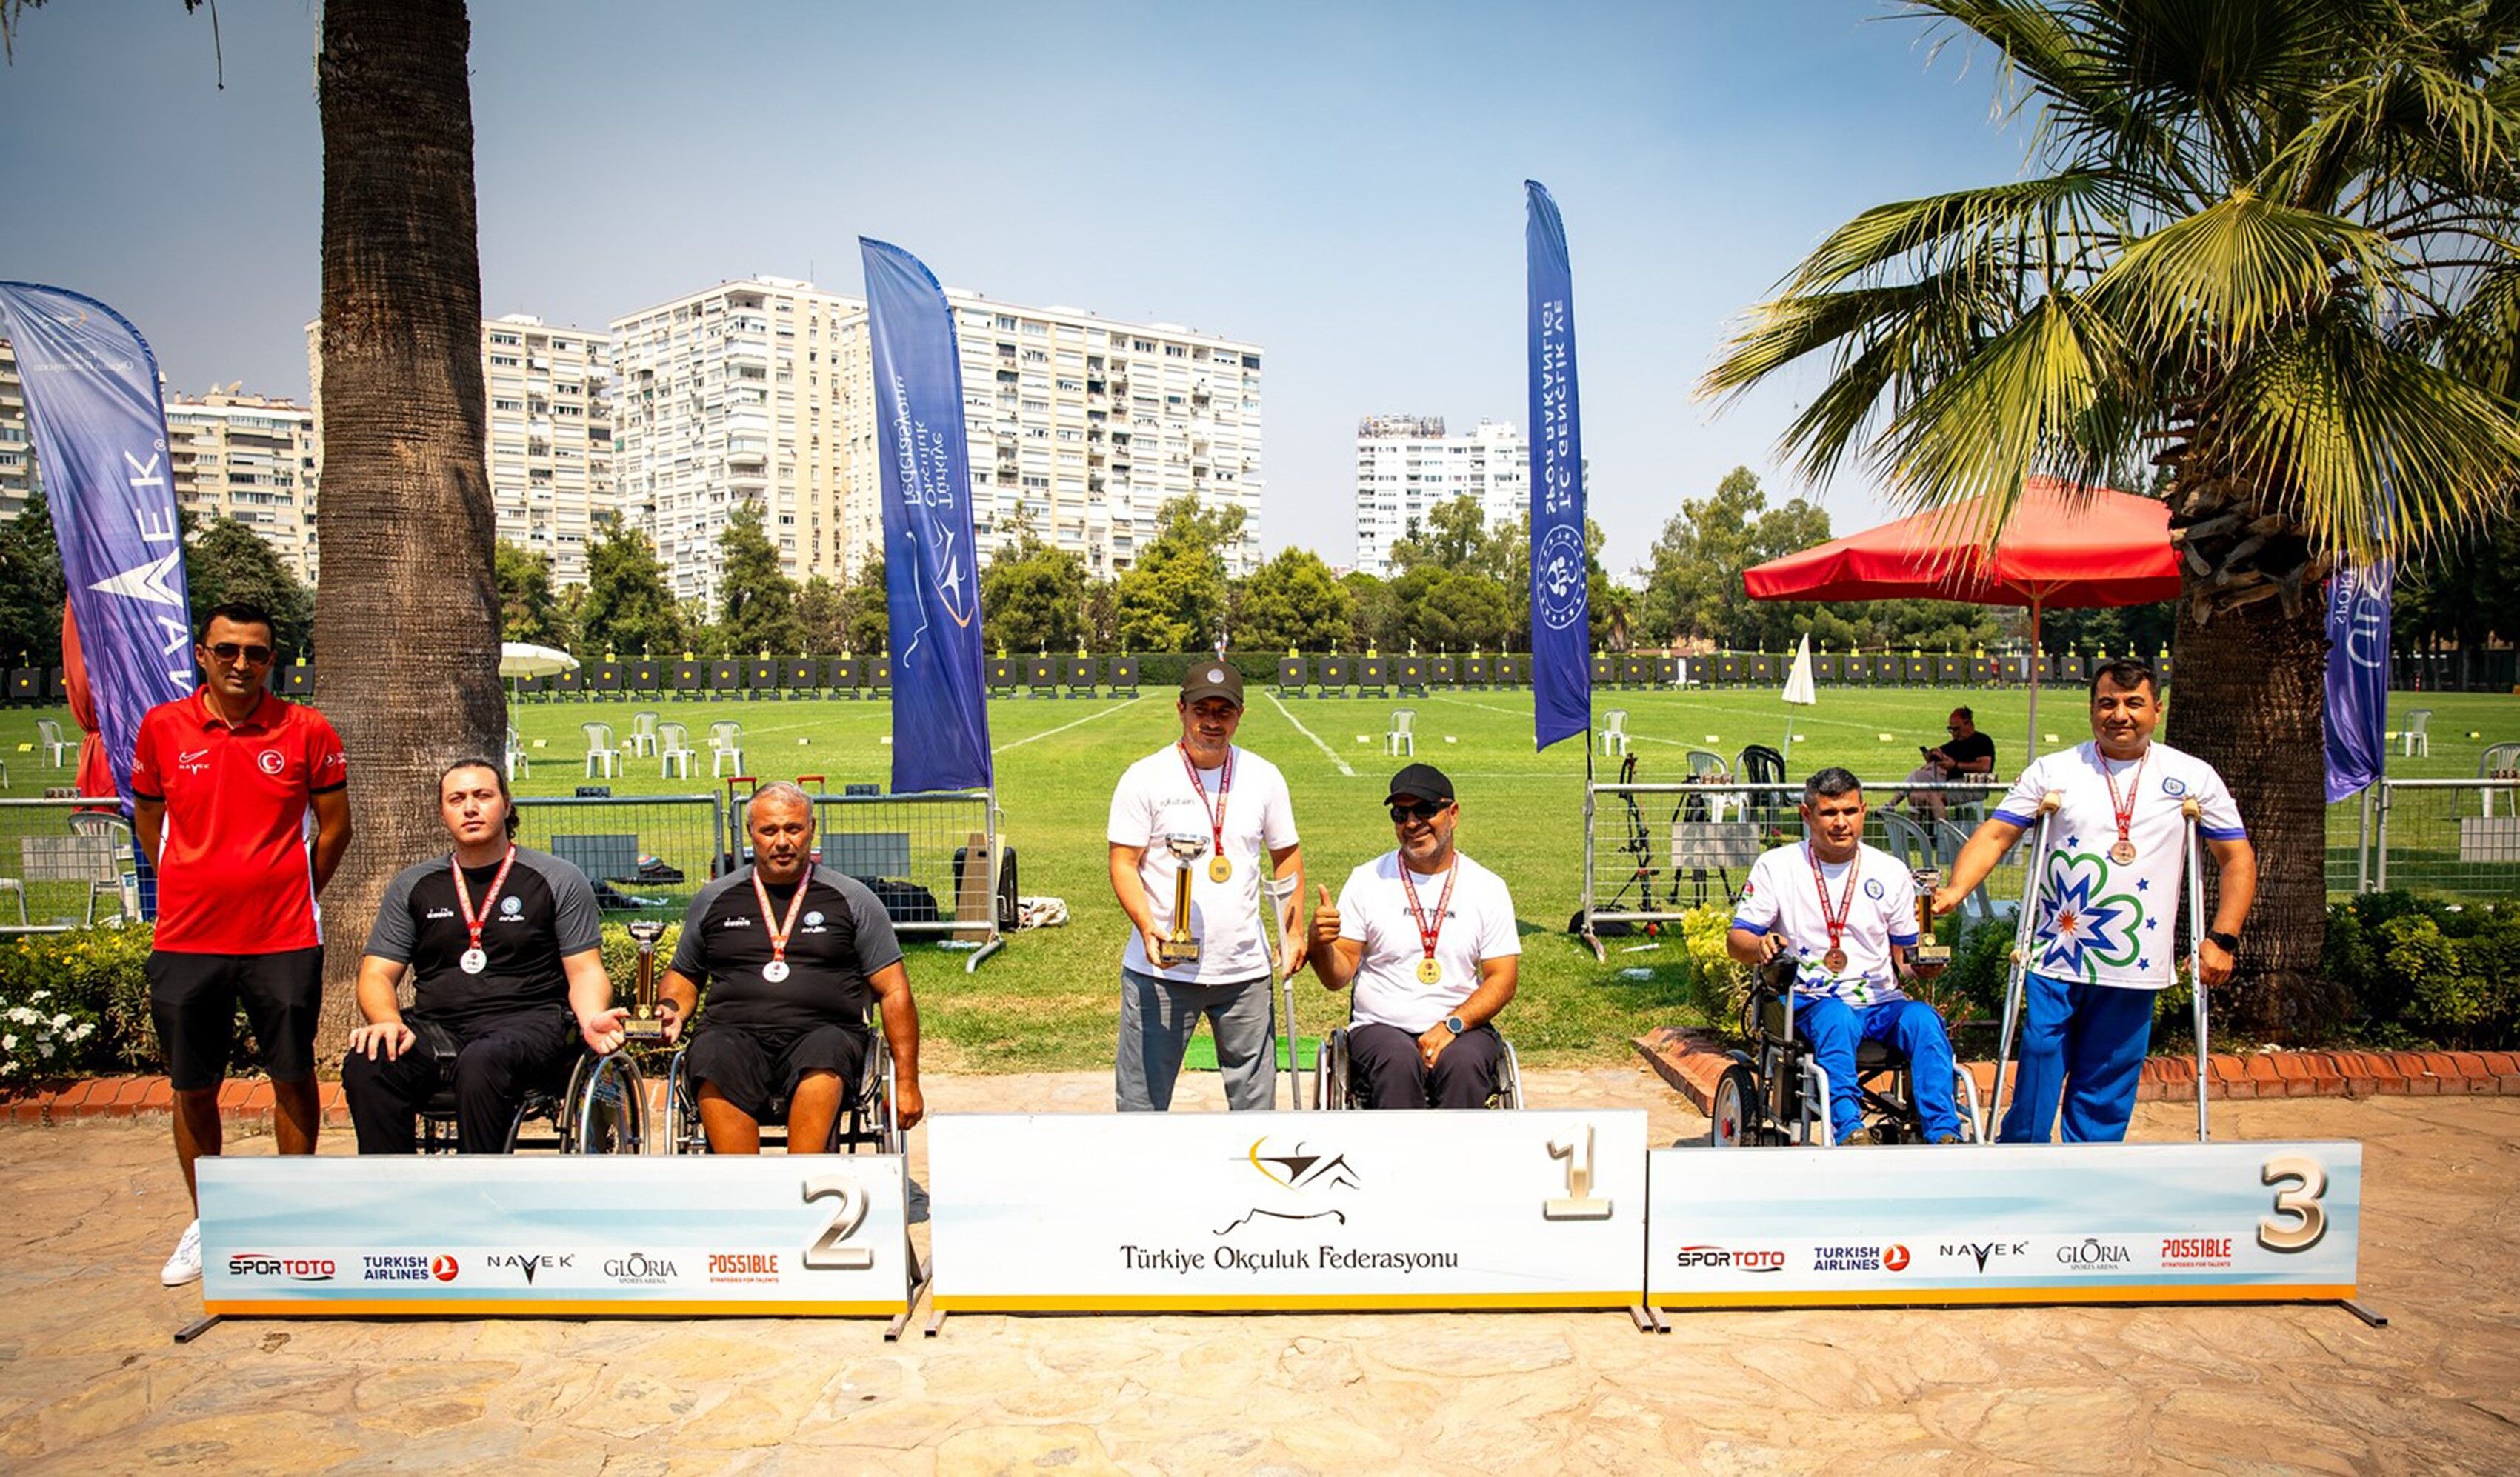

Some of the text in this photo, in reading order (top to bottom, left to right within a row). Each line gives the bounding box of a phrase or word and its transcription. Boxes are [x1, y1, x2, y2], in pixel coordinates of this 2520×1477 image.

[1542, 1122, 1614, 1221] 1
[2257, 1155, 2329, 1253] 3
[801, 1175, 874, 1270] 2
[1813, 1247, 1880, 1258] TURKISH
[2056, 1242, 2130, 1263] GLORIA
[2162, 1238, 2232, 1258] POSSIBLE
[363, 1256, 428, 1268] TURKISH
[604, 1255, 678, 1277] GLORIA
[709, 1254, 779, 1273] POSSIBLE
[1119, 1246, 1459, 1273] Türkiye Okçuluk Federasyonu
[1813, 1258, 1880, 1270] AIRLINES
[364, 1268, 430, 1280] AIRLINES
